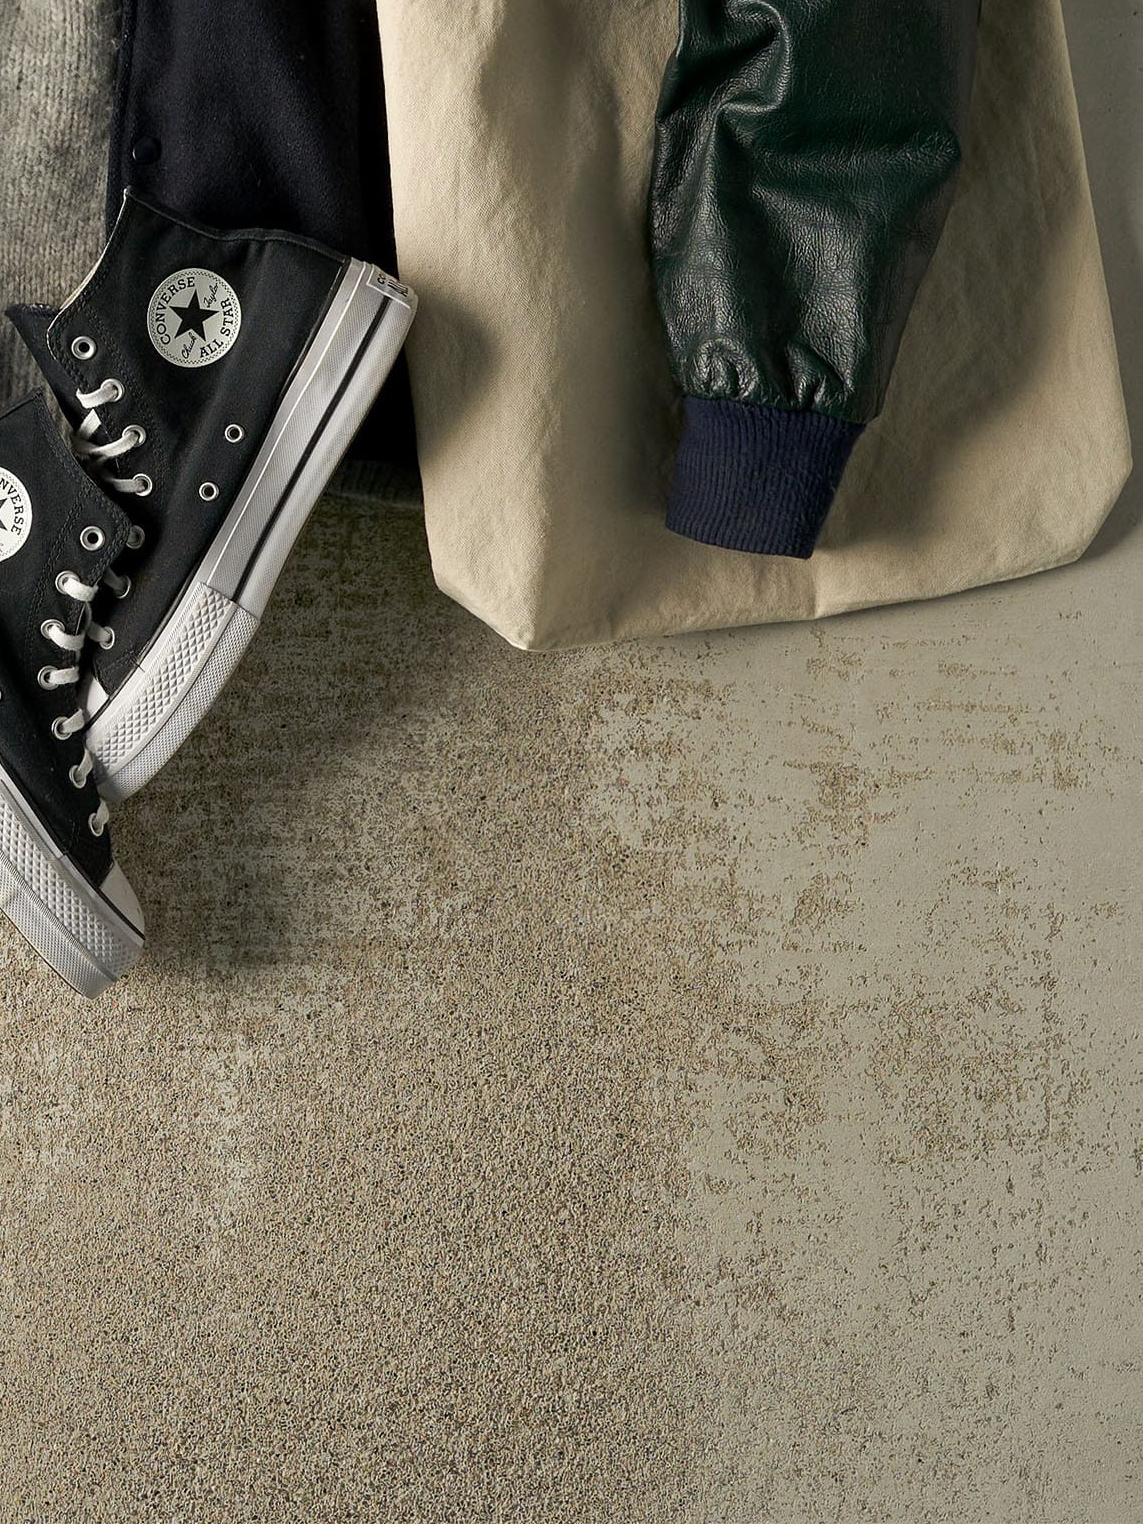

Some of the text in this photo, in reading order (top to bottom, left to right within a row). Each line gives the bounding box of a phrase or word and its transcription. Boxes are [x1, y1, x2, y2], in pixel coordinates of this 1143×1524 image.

[156, 277, 195, 345] CONVERSE
[200, 298, 233, 358] ALL STAR
